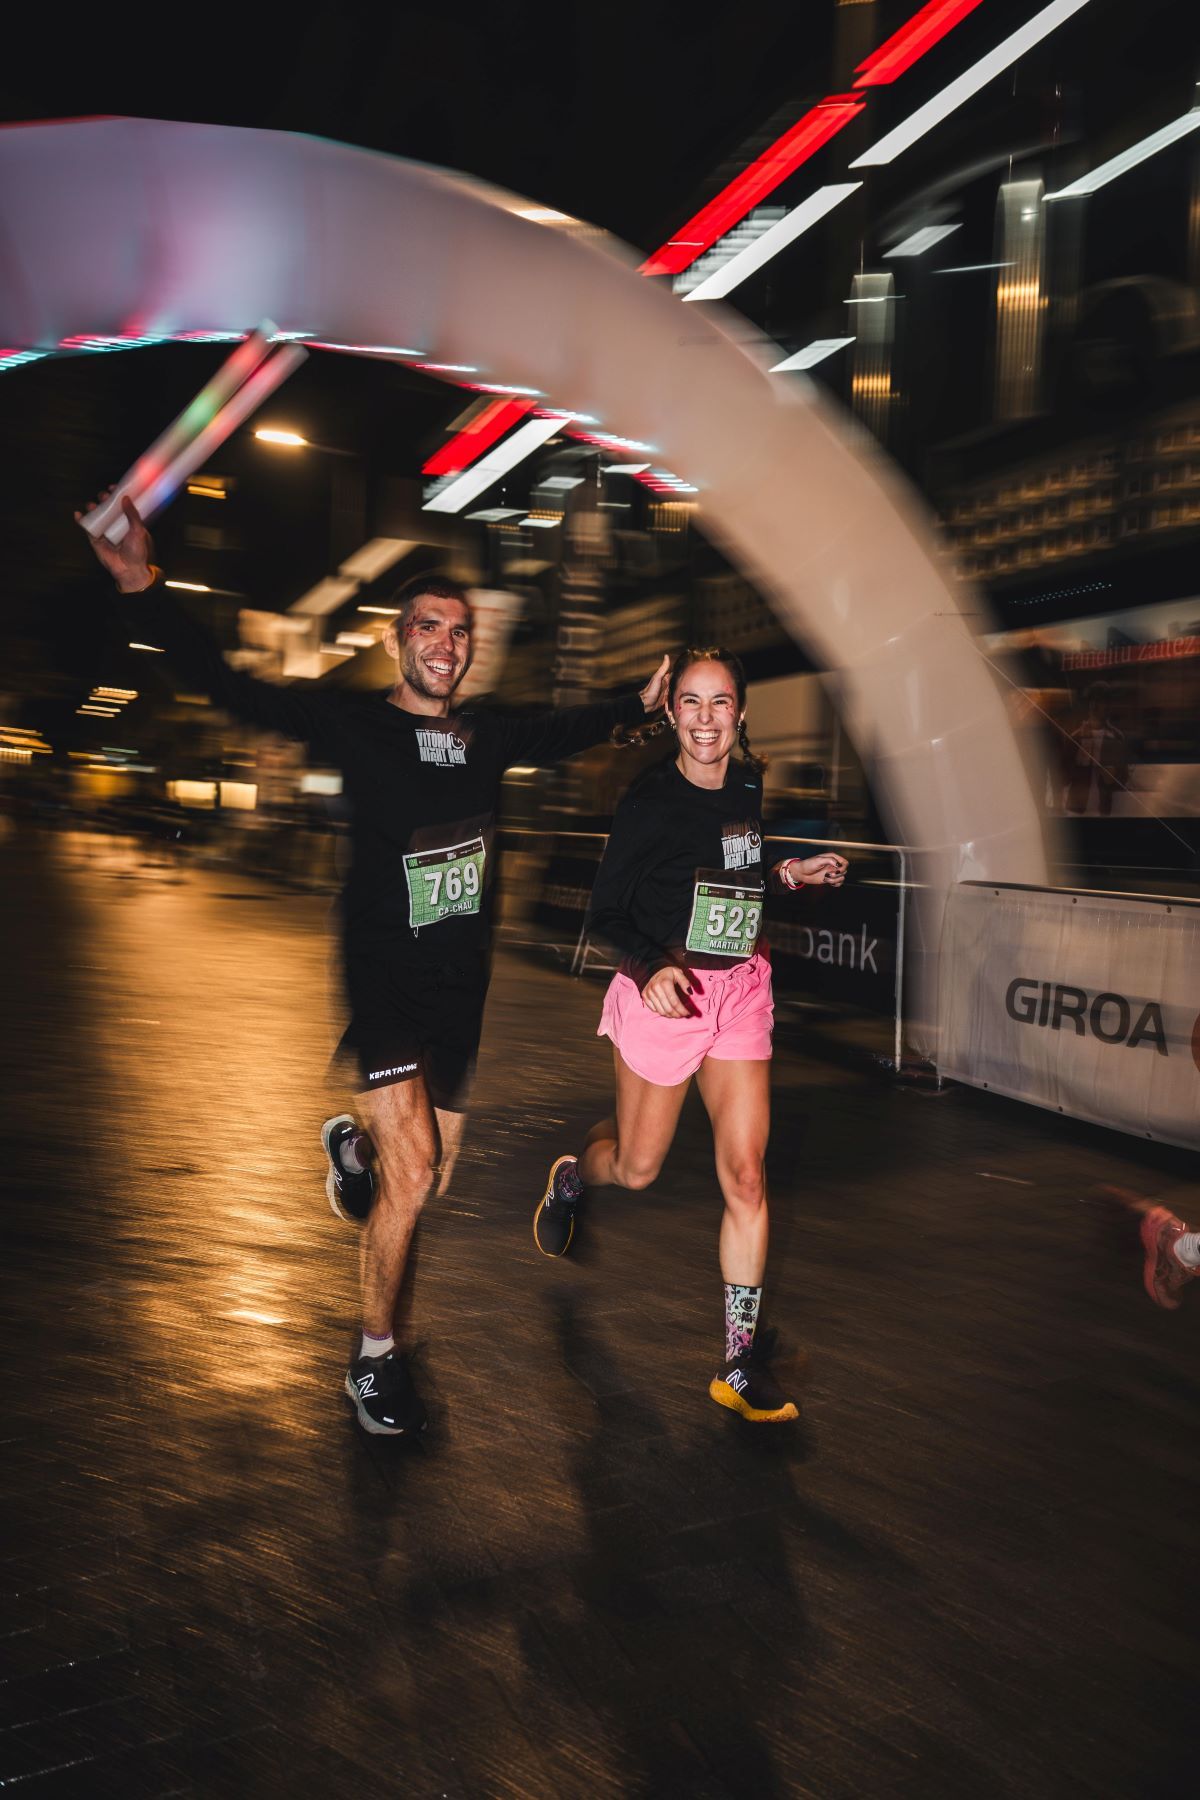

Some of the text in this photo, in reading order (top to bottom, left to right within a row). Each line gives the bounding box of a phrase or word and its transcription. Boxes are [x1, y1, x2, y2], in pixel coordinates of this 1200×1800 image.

[416, 731, 452, 749] VITORIA
[419, 746, 466, 764] NIGHT RUN
[722, 836, 750, 856] VITORIA
[724, 851, 745, 870] NIGHT
[424, 862, 479, 905] 769
[706, 904, 760, 940] 523
[1005, 977, 1169, 1057] GIROA
